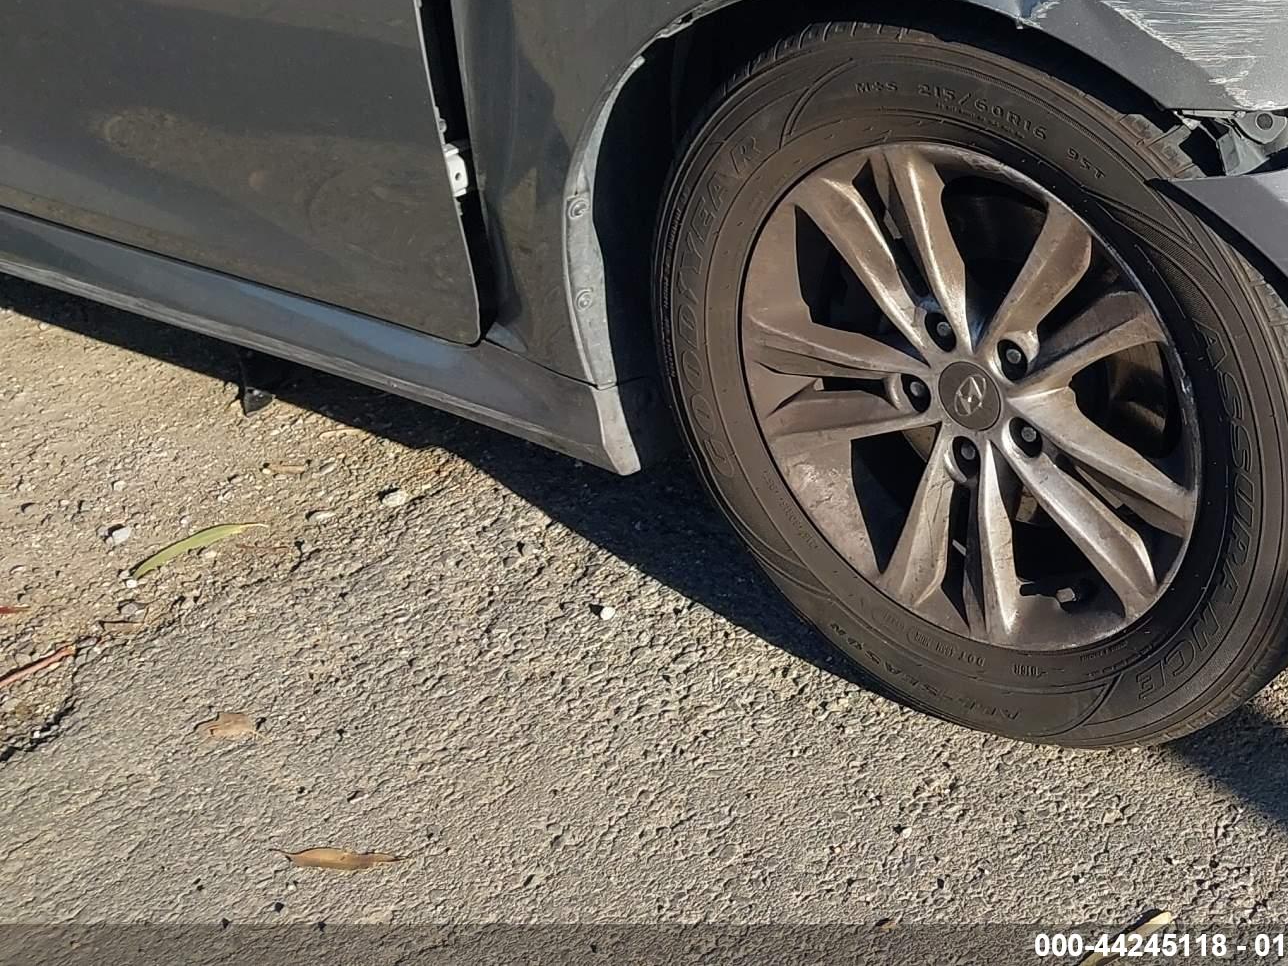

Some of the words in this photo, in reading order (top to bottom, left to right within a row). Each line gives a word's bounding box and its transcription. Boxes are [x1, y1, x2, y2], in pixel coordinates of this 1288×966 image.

[918, 83, 1047, 140] 215/60R16
[1066, 146, 1106, 179] 95T
[677, 136, 761, 477] GOODYEAR
[1136, 319, 1255, 700] ASSURANCE
